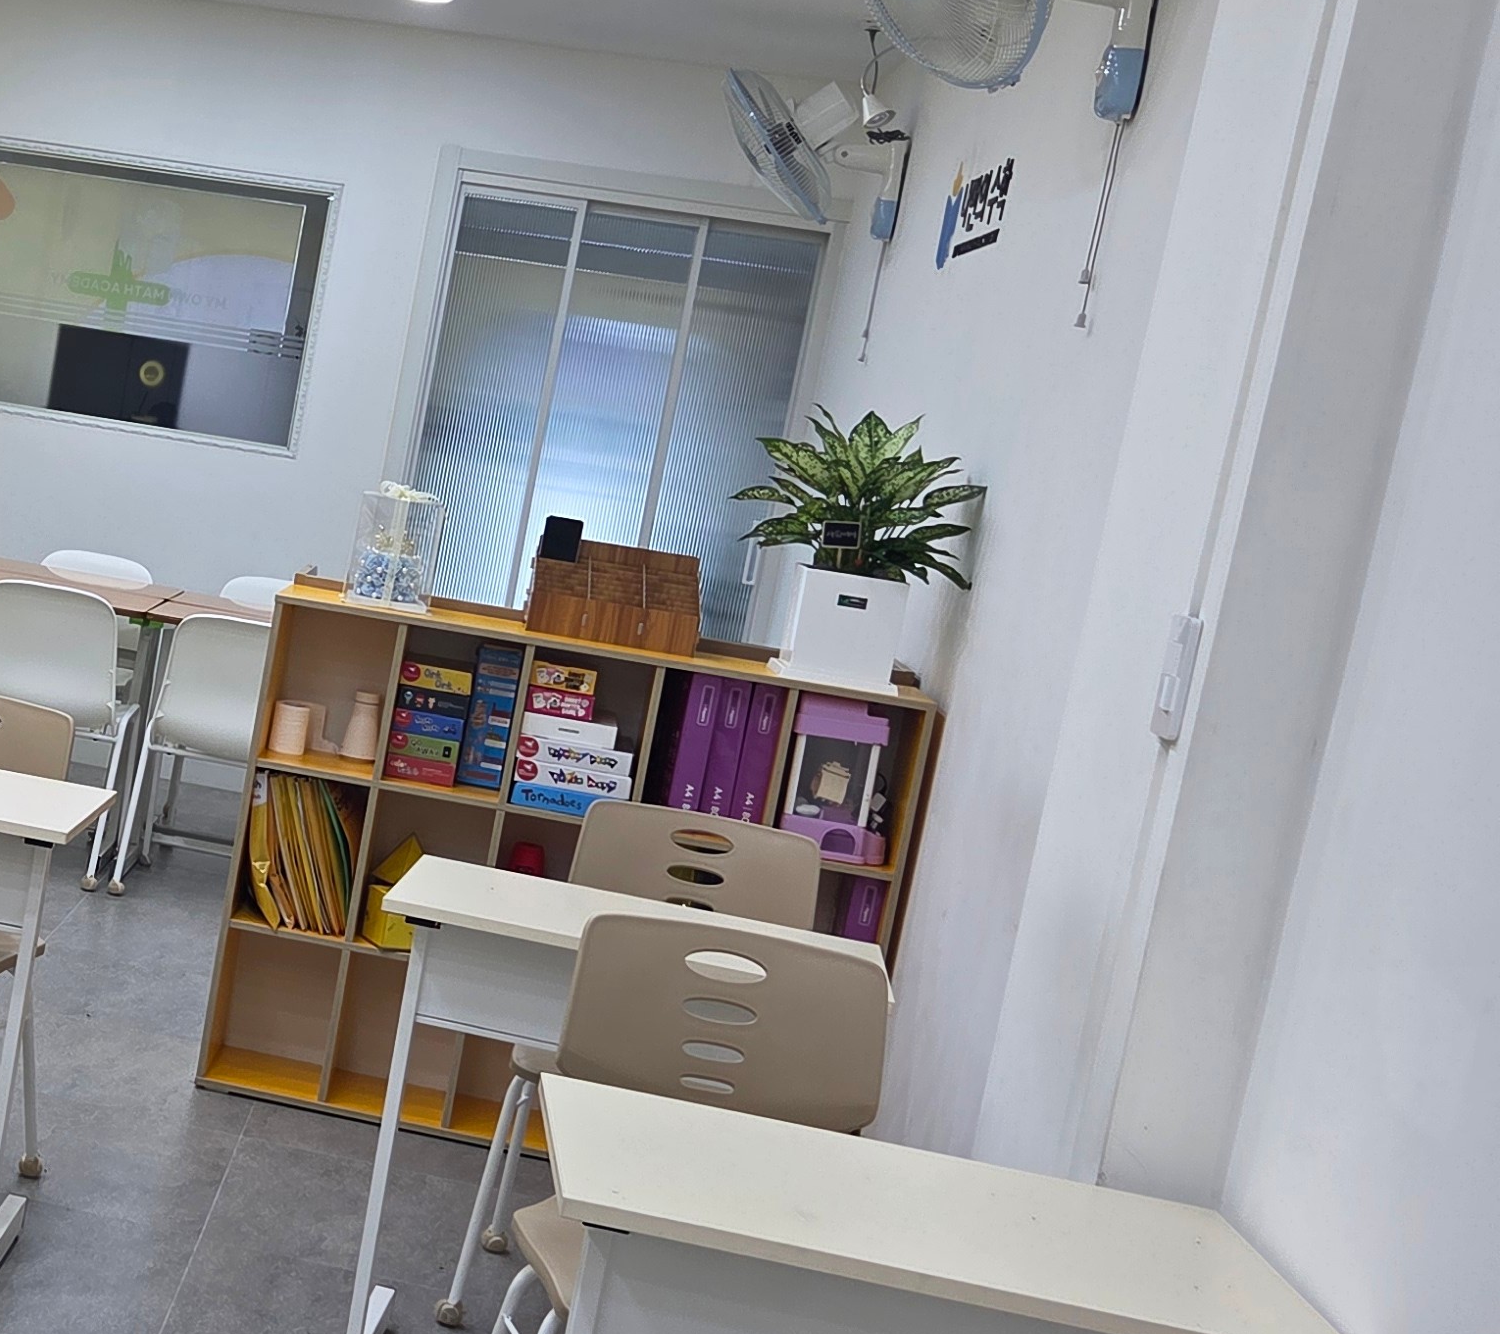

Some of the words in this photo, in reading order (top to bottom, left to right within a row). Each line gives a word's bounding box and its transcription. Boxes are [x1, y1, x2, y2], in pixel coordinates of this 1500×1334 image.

[684, 783, 694, 797] A4
[713, 787, 723, 800] A4
[521, 789, 582, 811] Tornadoes
[745, 792, 755, 805] A4
